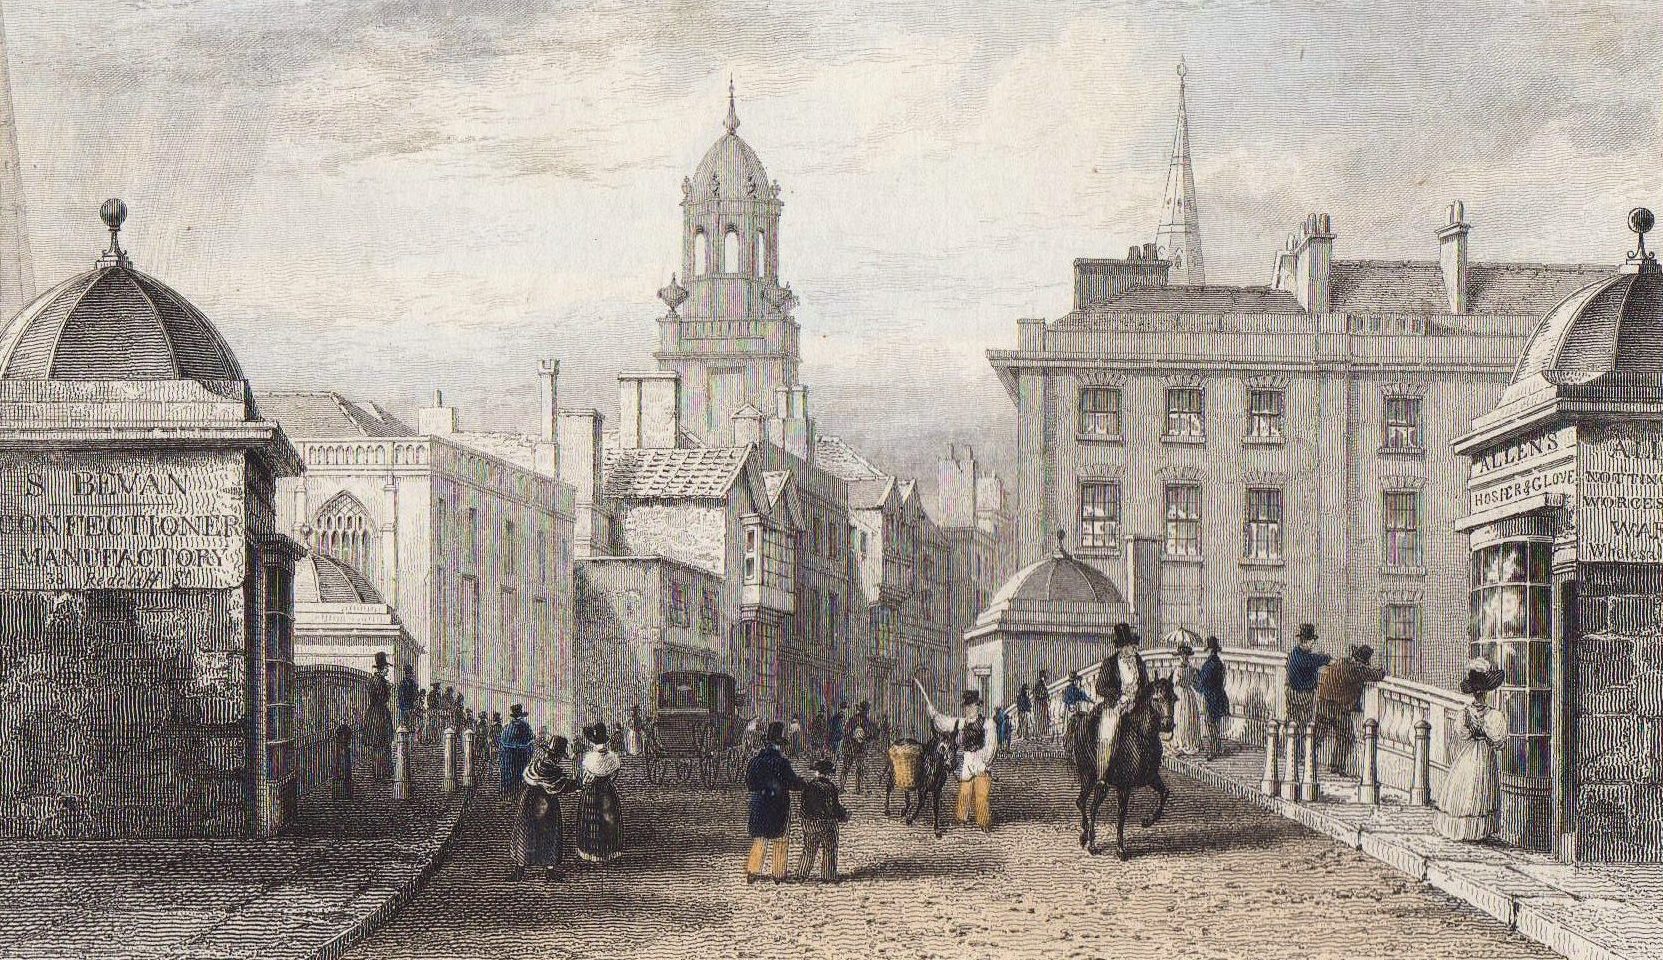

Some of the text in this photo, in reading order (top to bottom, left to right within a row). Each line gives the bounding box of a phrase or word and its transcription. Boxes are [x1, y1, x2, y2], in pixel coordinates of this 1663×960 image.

[26, 471, 189, 498] S BEVAN
[1585, 470, 1663, 487] NOTTIN
[0, 514, 240, 537] CONFECTIONER
[19, 547, 228, 569] MANUFACTORY
